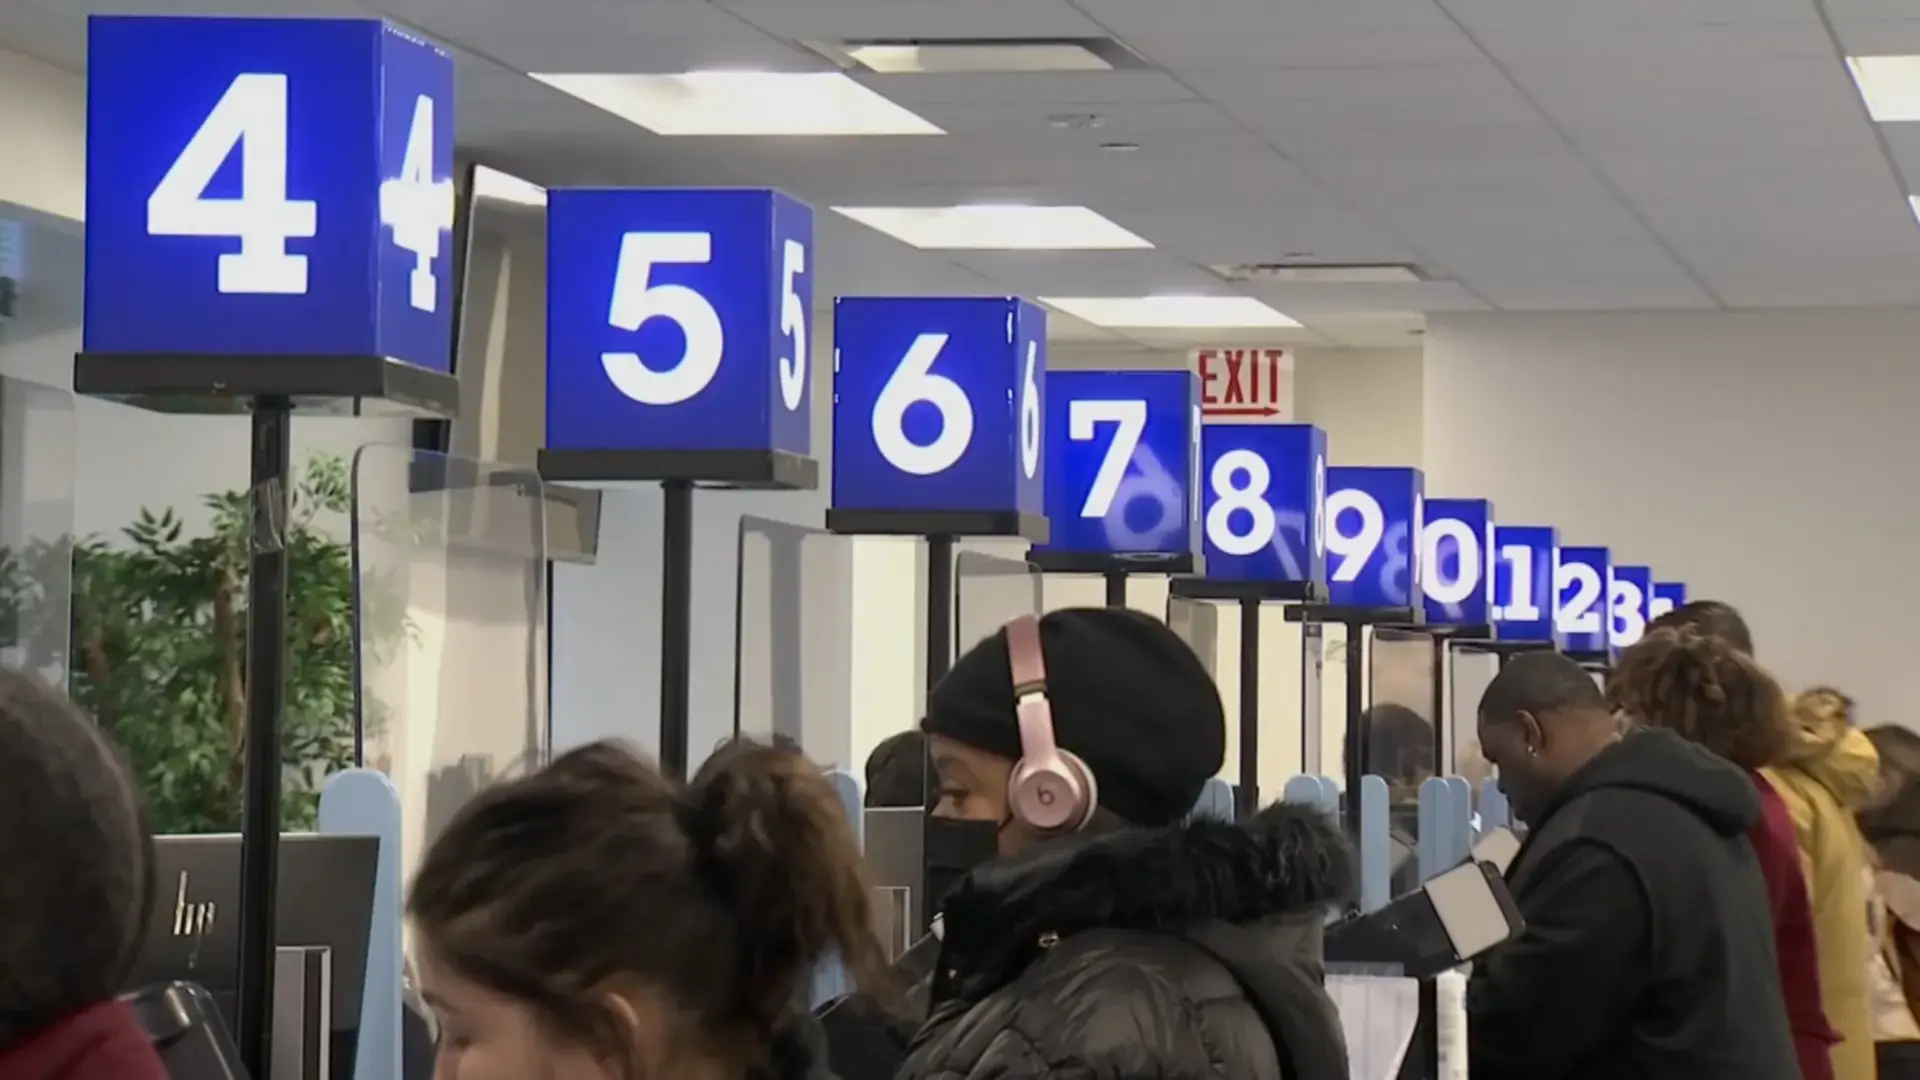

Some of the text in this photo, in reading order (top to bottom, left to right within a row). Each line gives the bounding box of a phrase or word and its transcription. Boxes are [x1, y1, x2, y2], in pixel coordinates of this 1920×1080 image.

[147, 73, 316, 294] 4
[380, 94, 454, 313] 4
[601, 231, 723, 405] 5
[779, 239, 805, 411] 5
[1198, 350, 1283, 404] EXIT
[872, 333, 973, 475] 6
[1021, 340, 1039, 480] 6
[1069, 400, 1147, 518] 7
[1206, 449, 1276, 555] 8
[1325, 488, 1384, 581] 9
